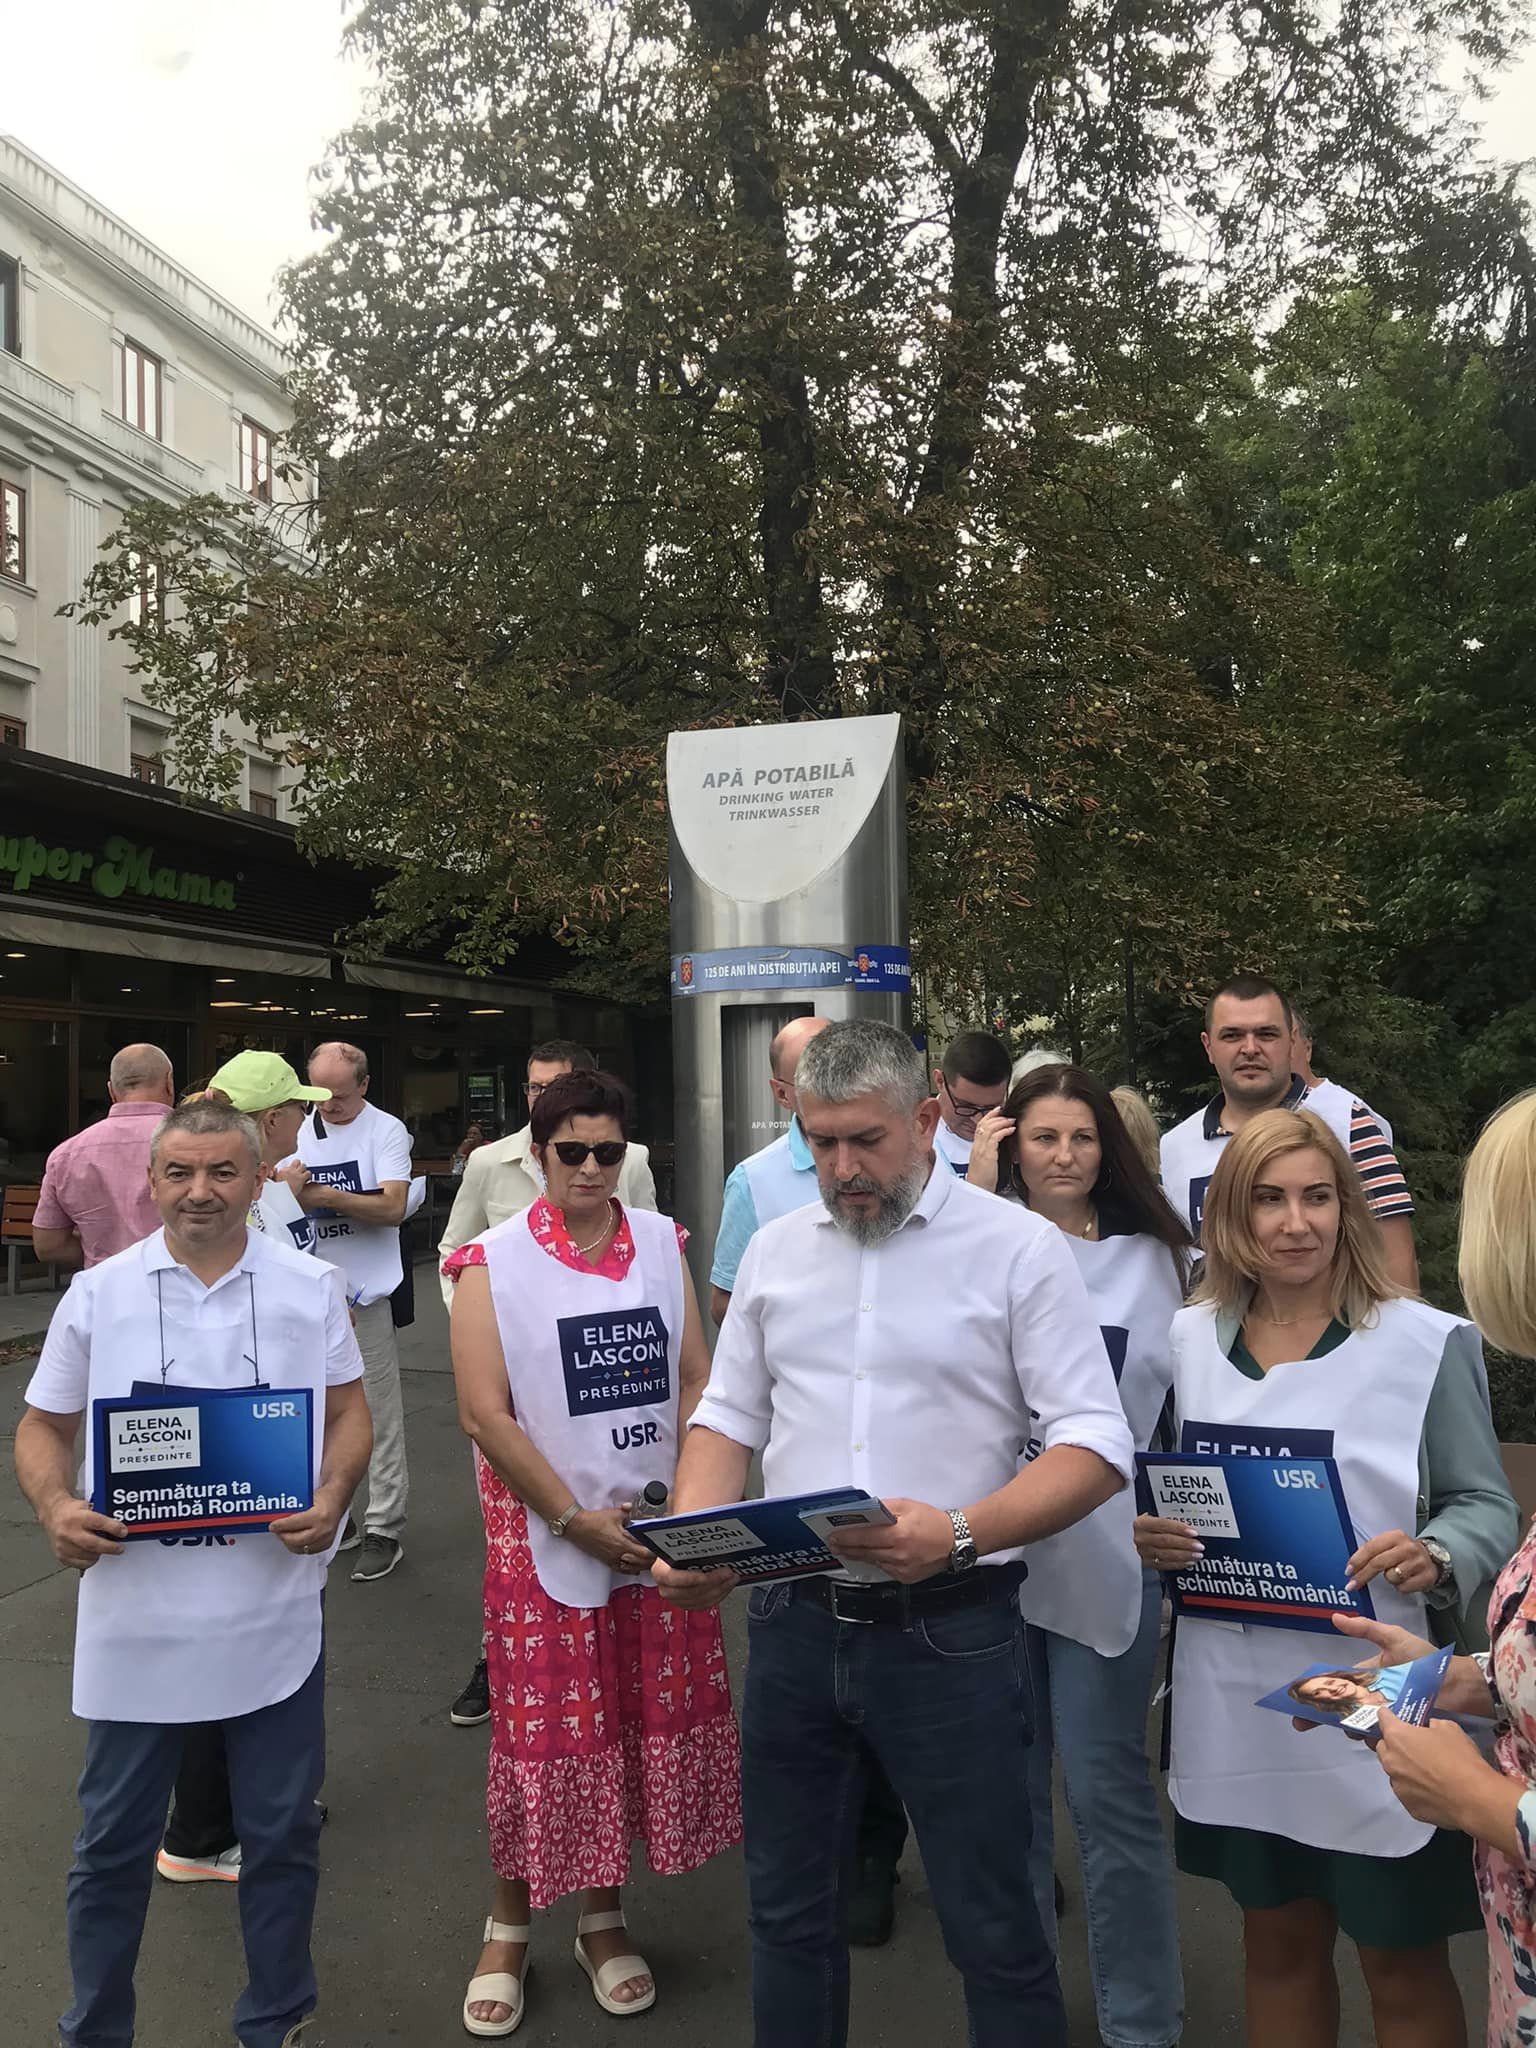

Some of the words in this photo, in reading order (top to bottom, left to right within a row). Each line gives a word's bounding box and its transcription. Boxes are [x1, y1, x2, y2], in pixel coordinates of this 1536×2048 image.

[702, 768, 744, 789] APĂ
[753, 757, 855, 786] POTABILĂ
[719, 792, 784, 806] DRINKING
[789, 787, 834, 801] WATER
[728, 805, 820, 821] TRINKWASSER
[0, 836, 93, 890] uper
[93, 836, 237, 910] Mama
[704, 967, 718, 979] 125
[719, 967, 730, 977] DE
[730, 966, 746, 977] ANI
[747, 962, 758, 976] ÎN
[819, 962, 841, 974] APEI
[309, 1171, 347, 1183] LENA
[318, 1223, 354, 1240] USR.
[583, 1320, 657, 1346] ELENA
[573, 1340, 665, 1370] LASCONI
[579, 1378, 667, 1401] PREȘEDINTE
[252, 1401, 300, 1419] USR.
[126, 1416, 183, 1431] ELENA
[118, 1429, 192, 1445] LASCONI
[611, 1421, 662, 1451] USR.
[119, 1452, 192, 1465] PREȘEDINTE
[1162, 1475, 1213, 1490] ELENA
[1273, 1468, 1324, 1489] USR.
[112, 1483, 228, 1505] Semnătura
[231, 1481, 252, 1496] ta
[1160, 1491, 1225, 1506] LASCONI
[112, 1503, 204, 1523] schimbă
[208, 1493, 304, 1515] România.
[664, 1530, 745, 1549] LASCONI
[665, 1525, 729, 1541] ELENA
[734, 1560, 791, 1576] imbă
[1184, 1556, 1274, 1579] emnătura
[1276, 1561, 1298, 1580] ta
[1176, 1573, 1257, 1598] schimbă
[1262, 1580, 1358, 1607] România.
